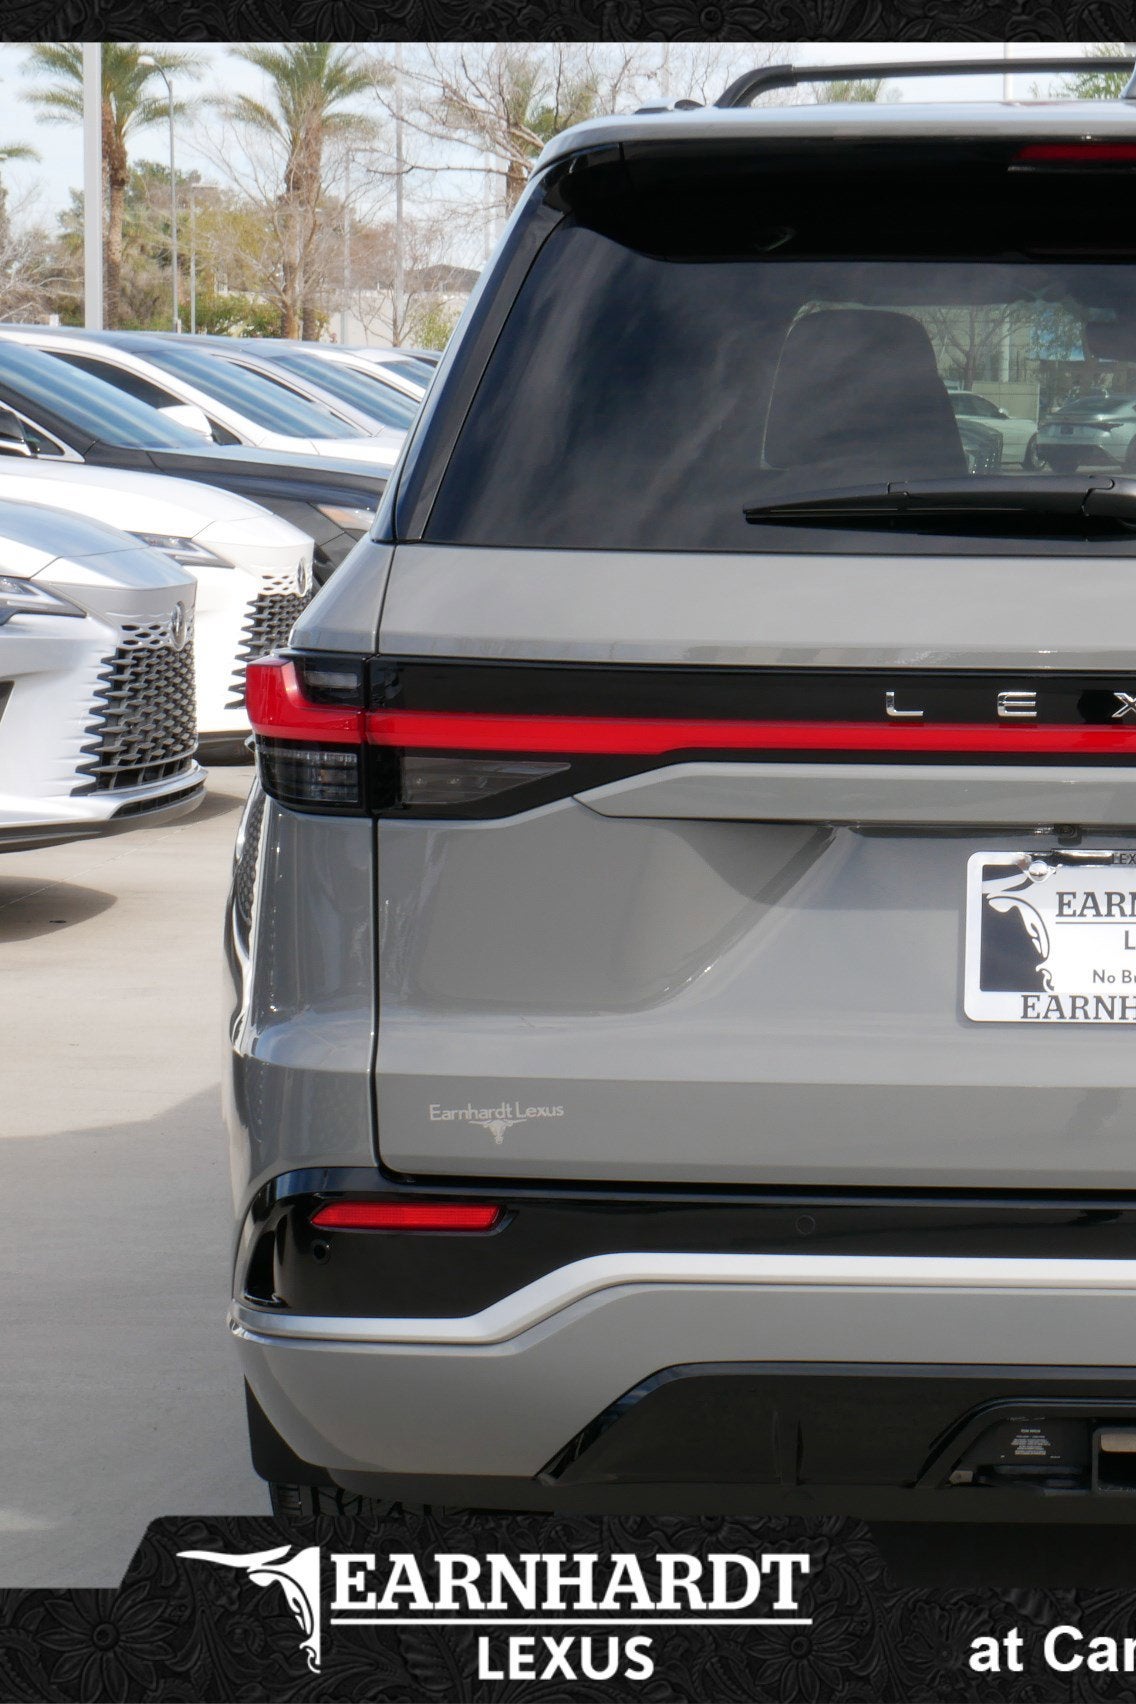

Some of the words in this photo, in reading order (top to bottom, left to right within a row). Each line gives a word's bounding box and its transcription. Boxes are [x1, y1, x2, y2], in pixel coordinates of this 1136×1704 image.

[1092, 969, 1116, 984] No
[429, 1102, 513, 1121] Earnhardt
[515, 1102, 564, 1118] Lexus
